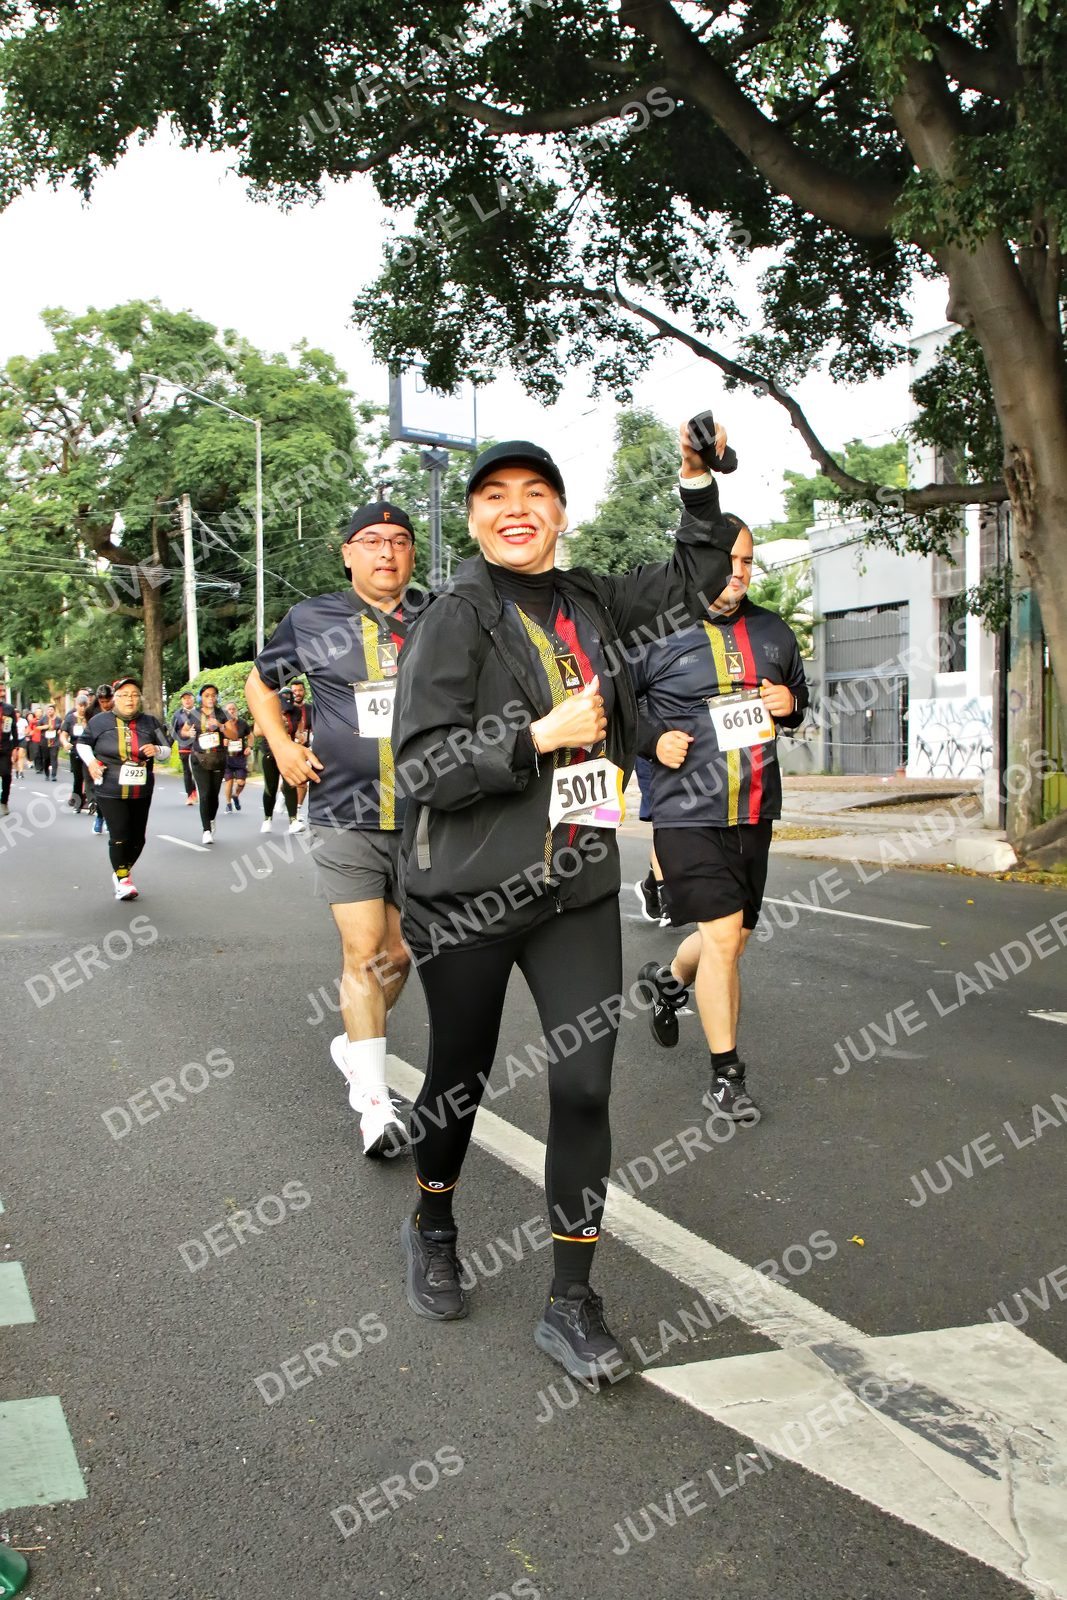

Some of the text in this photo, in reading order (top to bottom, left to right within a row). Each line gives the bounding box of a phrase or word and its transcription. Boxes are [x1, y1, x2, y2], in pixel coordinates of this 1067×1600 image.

[383, 511, 391, 521] F
[367, 697, 394, 716] 49
[722, 706, 763, 730] 6618
[125, 768, 144, 777] 2925
[557, 770, 607, 809] 5017
